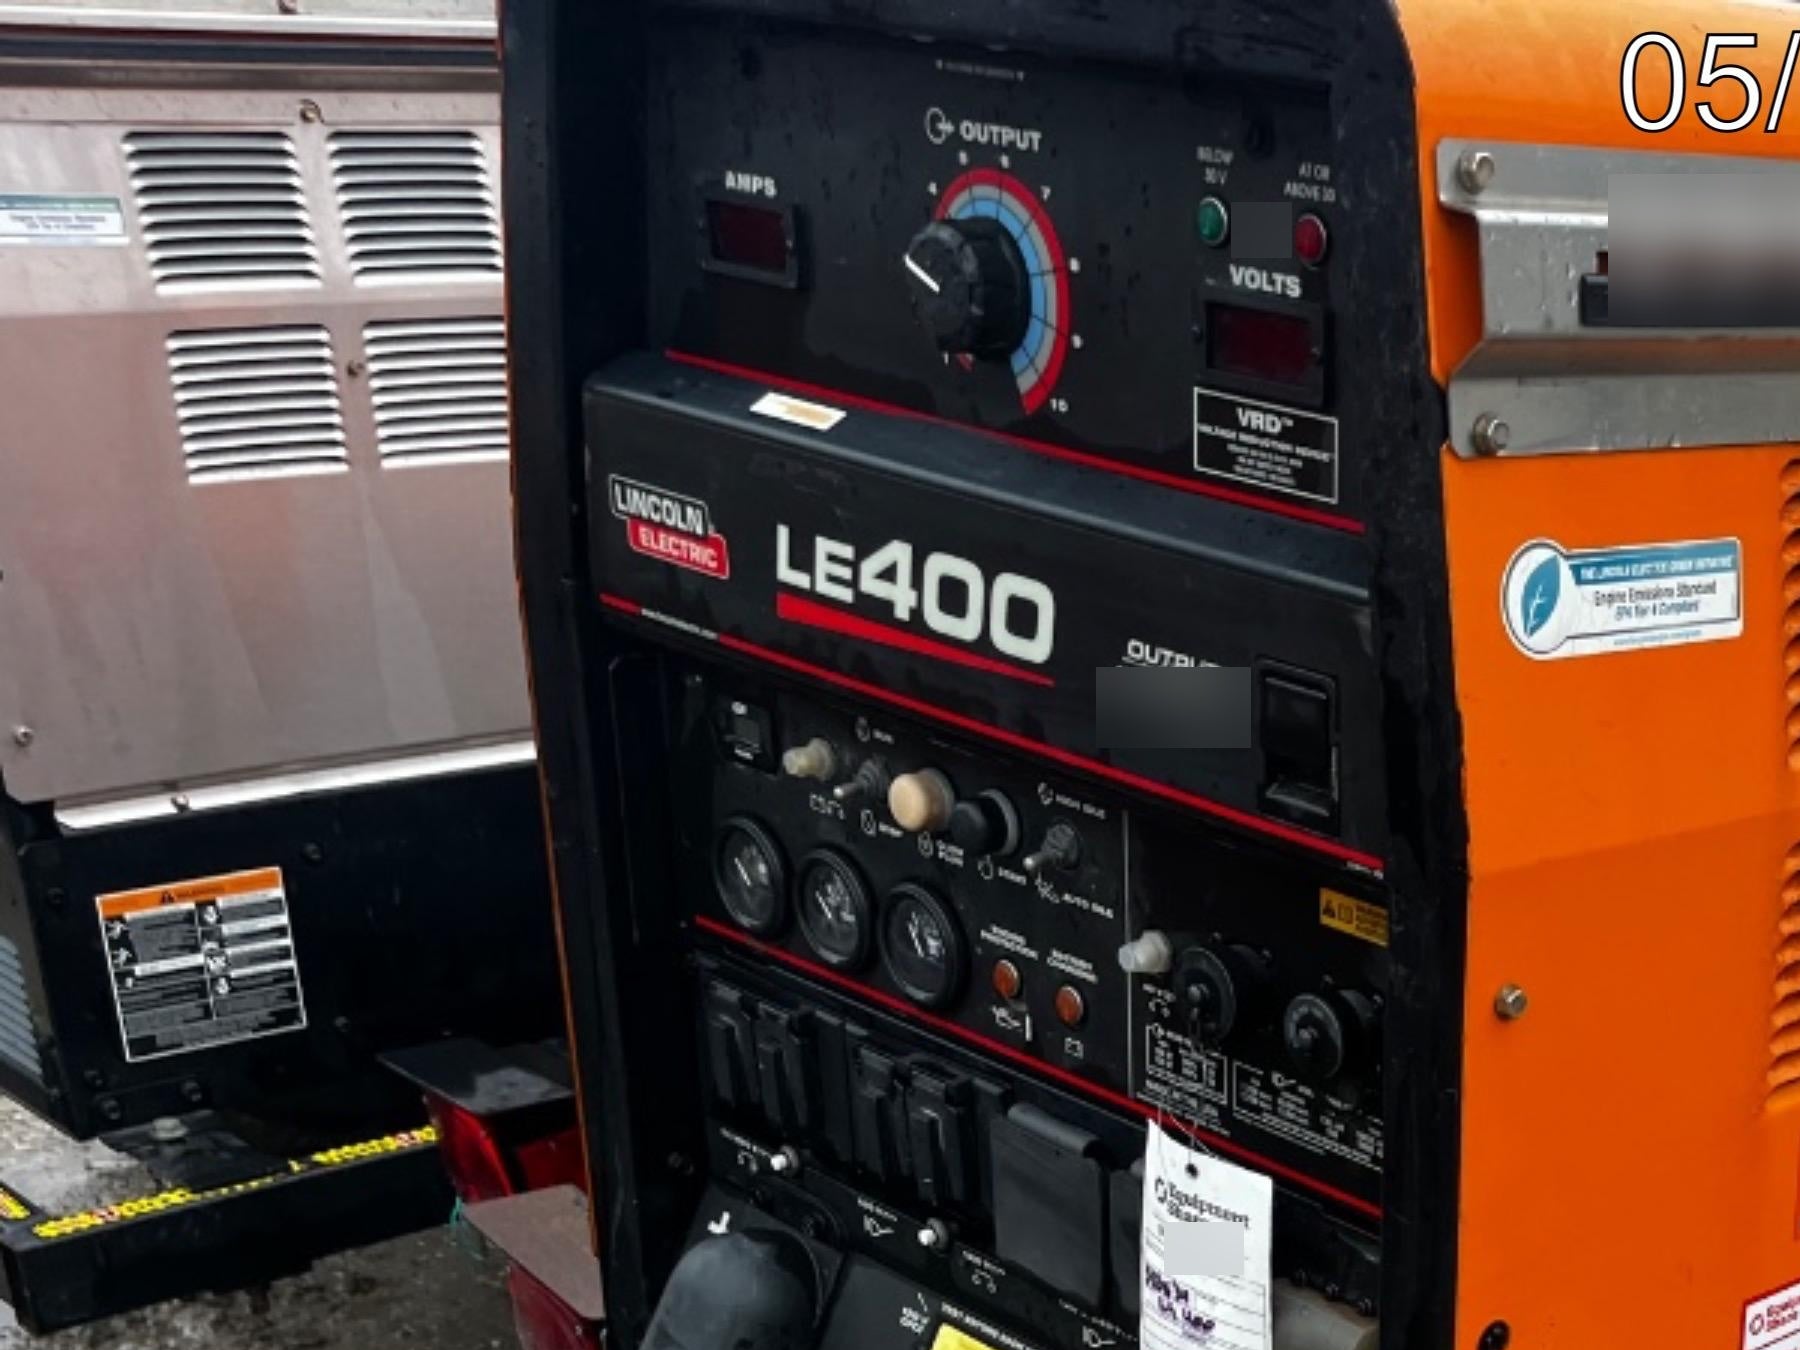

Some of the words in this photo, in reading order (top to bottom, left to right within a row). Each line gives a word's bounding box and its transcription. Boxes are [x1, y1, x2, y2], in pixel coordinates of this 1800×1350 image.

[959, 120, 1042, 151] OUTPUT
[725, 170, 777, 198] AMPS
[1229, 264, 1302, 298] VOLTS
[614, 482, 704, 536] LINCOLN
[638, 525, 718, 568] ELECTRIC
[776, 523, 1054, 664] LE400
